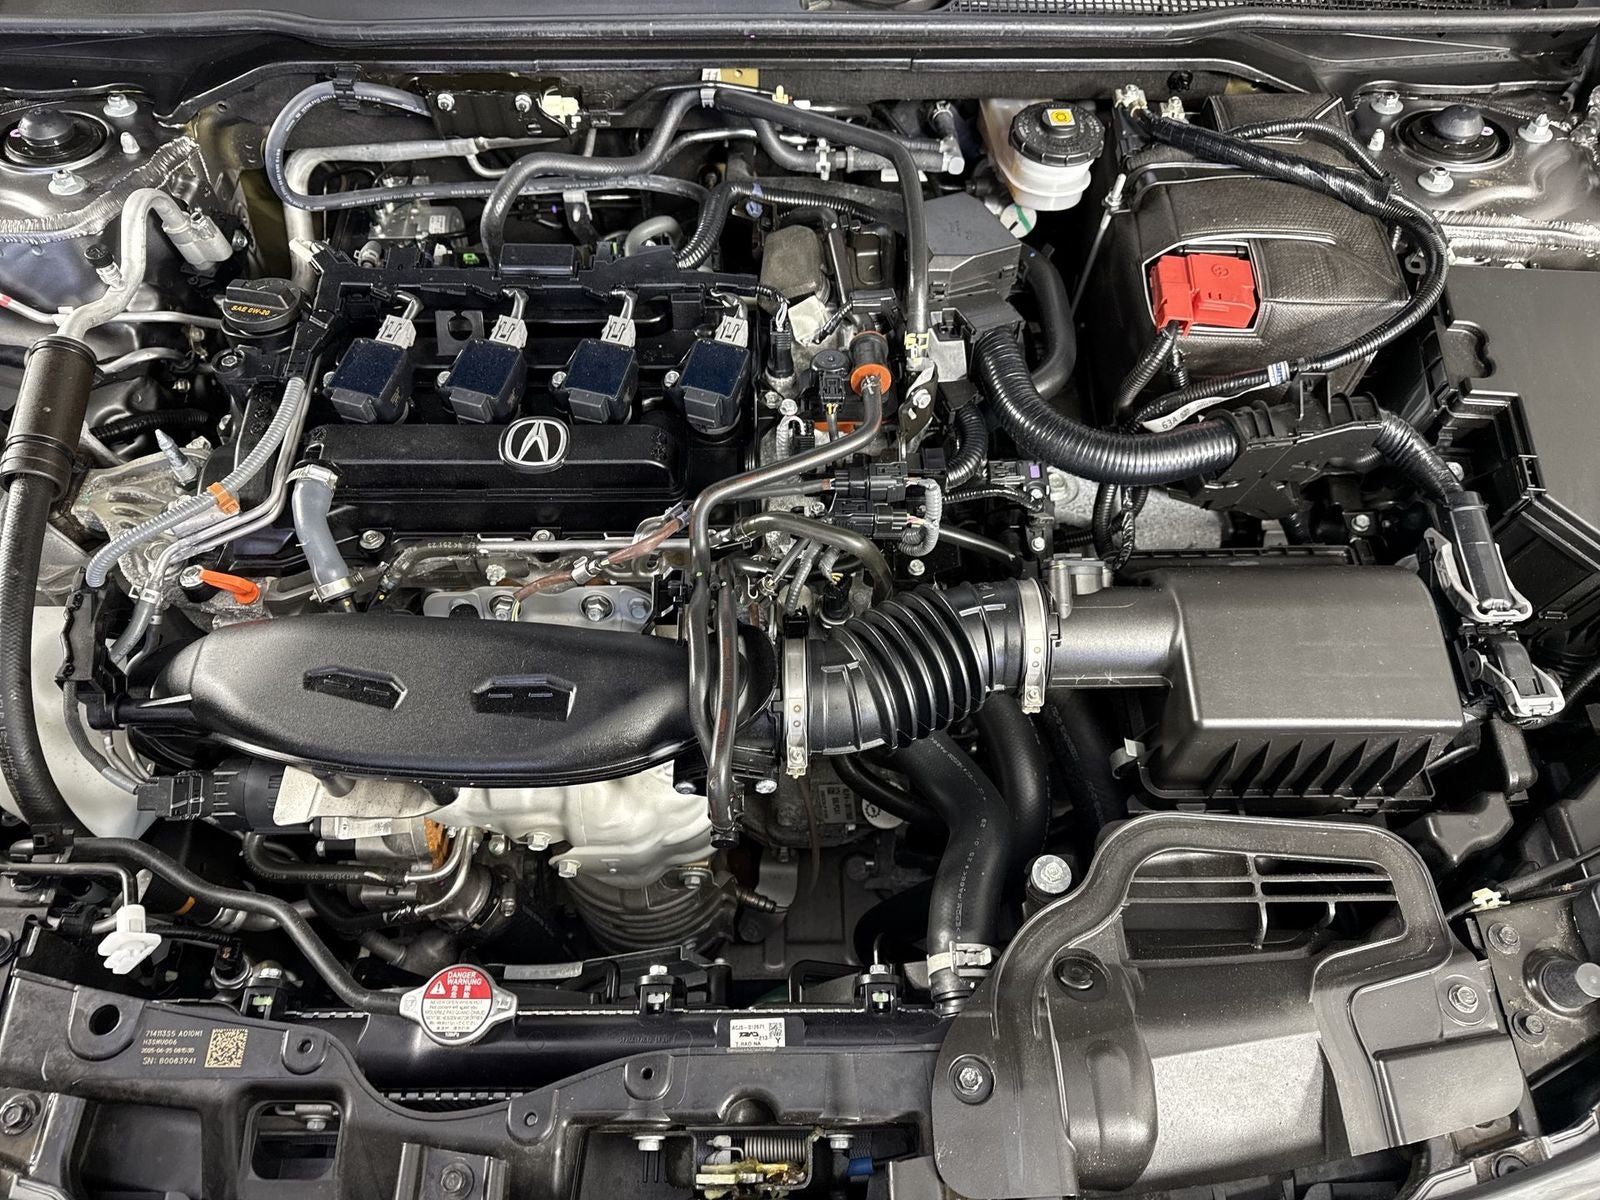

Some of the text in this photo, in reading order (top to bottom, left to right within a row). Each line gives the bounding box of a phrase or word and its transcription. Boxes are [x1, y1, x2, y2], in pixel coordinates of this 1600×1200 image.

[231, 305, 271, 316] SAE 0W-20
[1162, 416, 1178, 430] 63A
[447, 971, 477, 979] DANGER
[447, 978, 482, 986] WARNUNG
